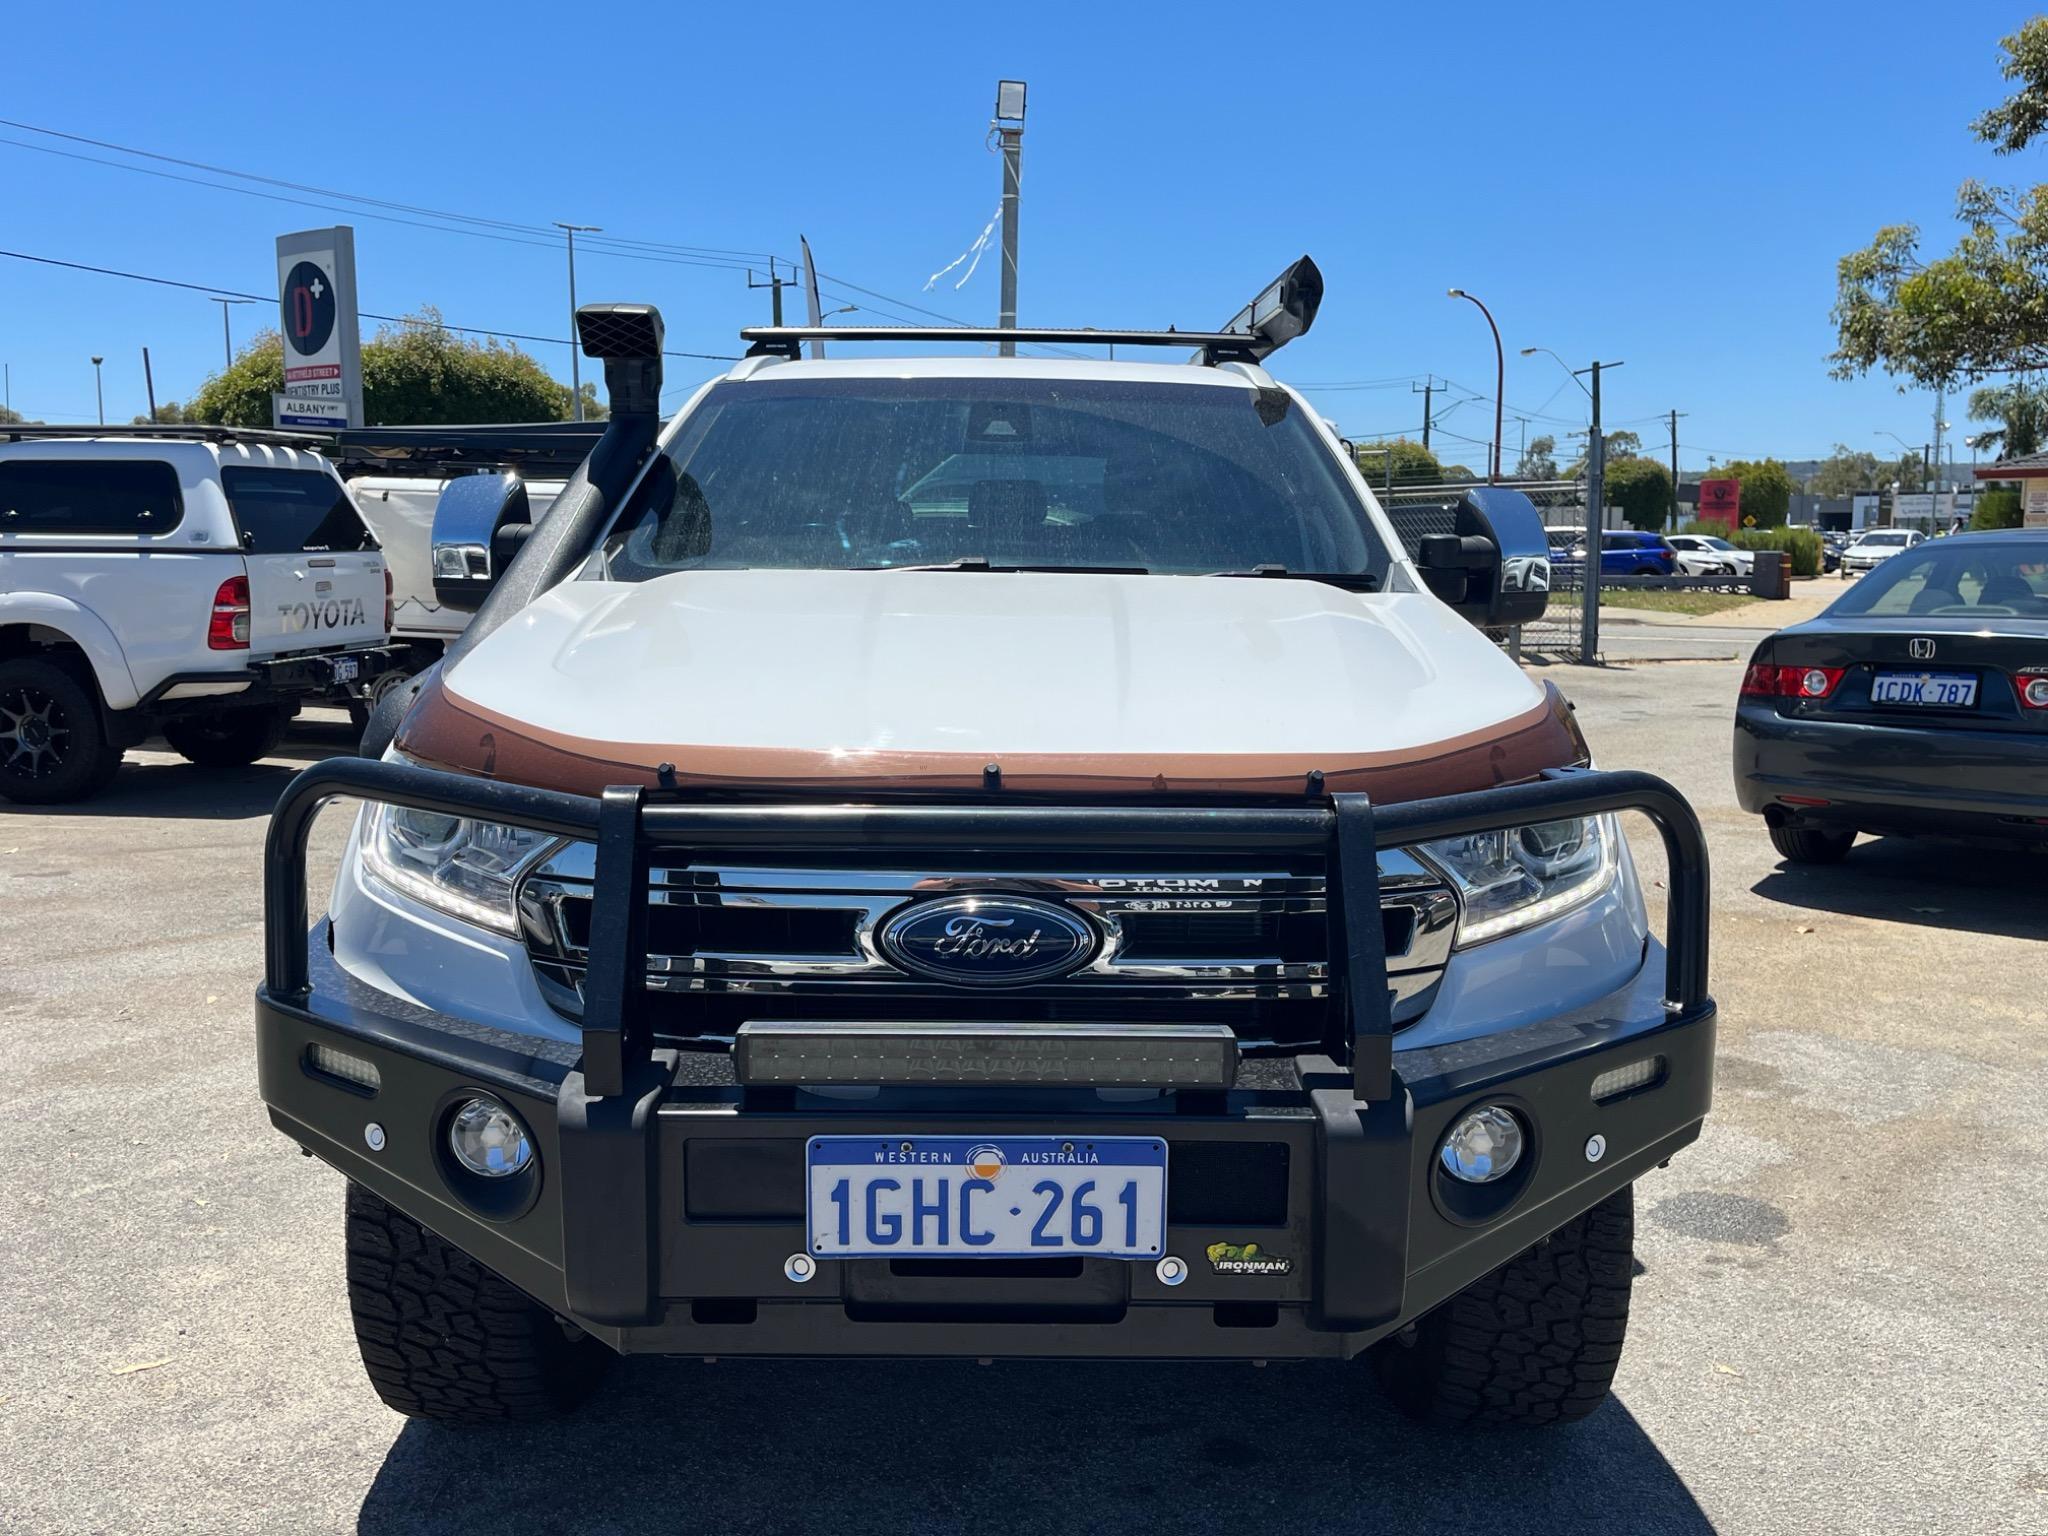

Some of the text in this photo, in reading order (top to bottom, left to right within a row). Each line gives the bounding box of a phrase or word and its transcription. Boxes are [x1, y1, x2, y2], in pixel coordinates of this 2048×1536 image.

[321, 383, 340, 395] PLUS
[286, 402, 326, 415] ALBANY
[277, 598, 366, 633] TOYOTA
[934, 916, 1041, 957] Ford
[874, 1152, 1099, 1164] WESTERN AUSTRALIA
[1218, 1261, 1286, 1270] IRONMAN
